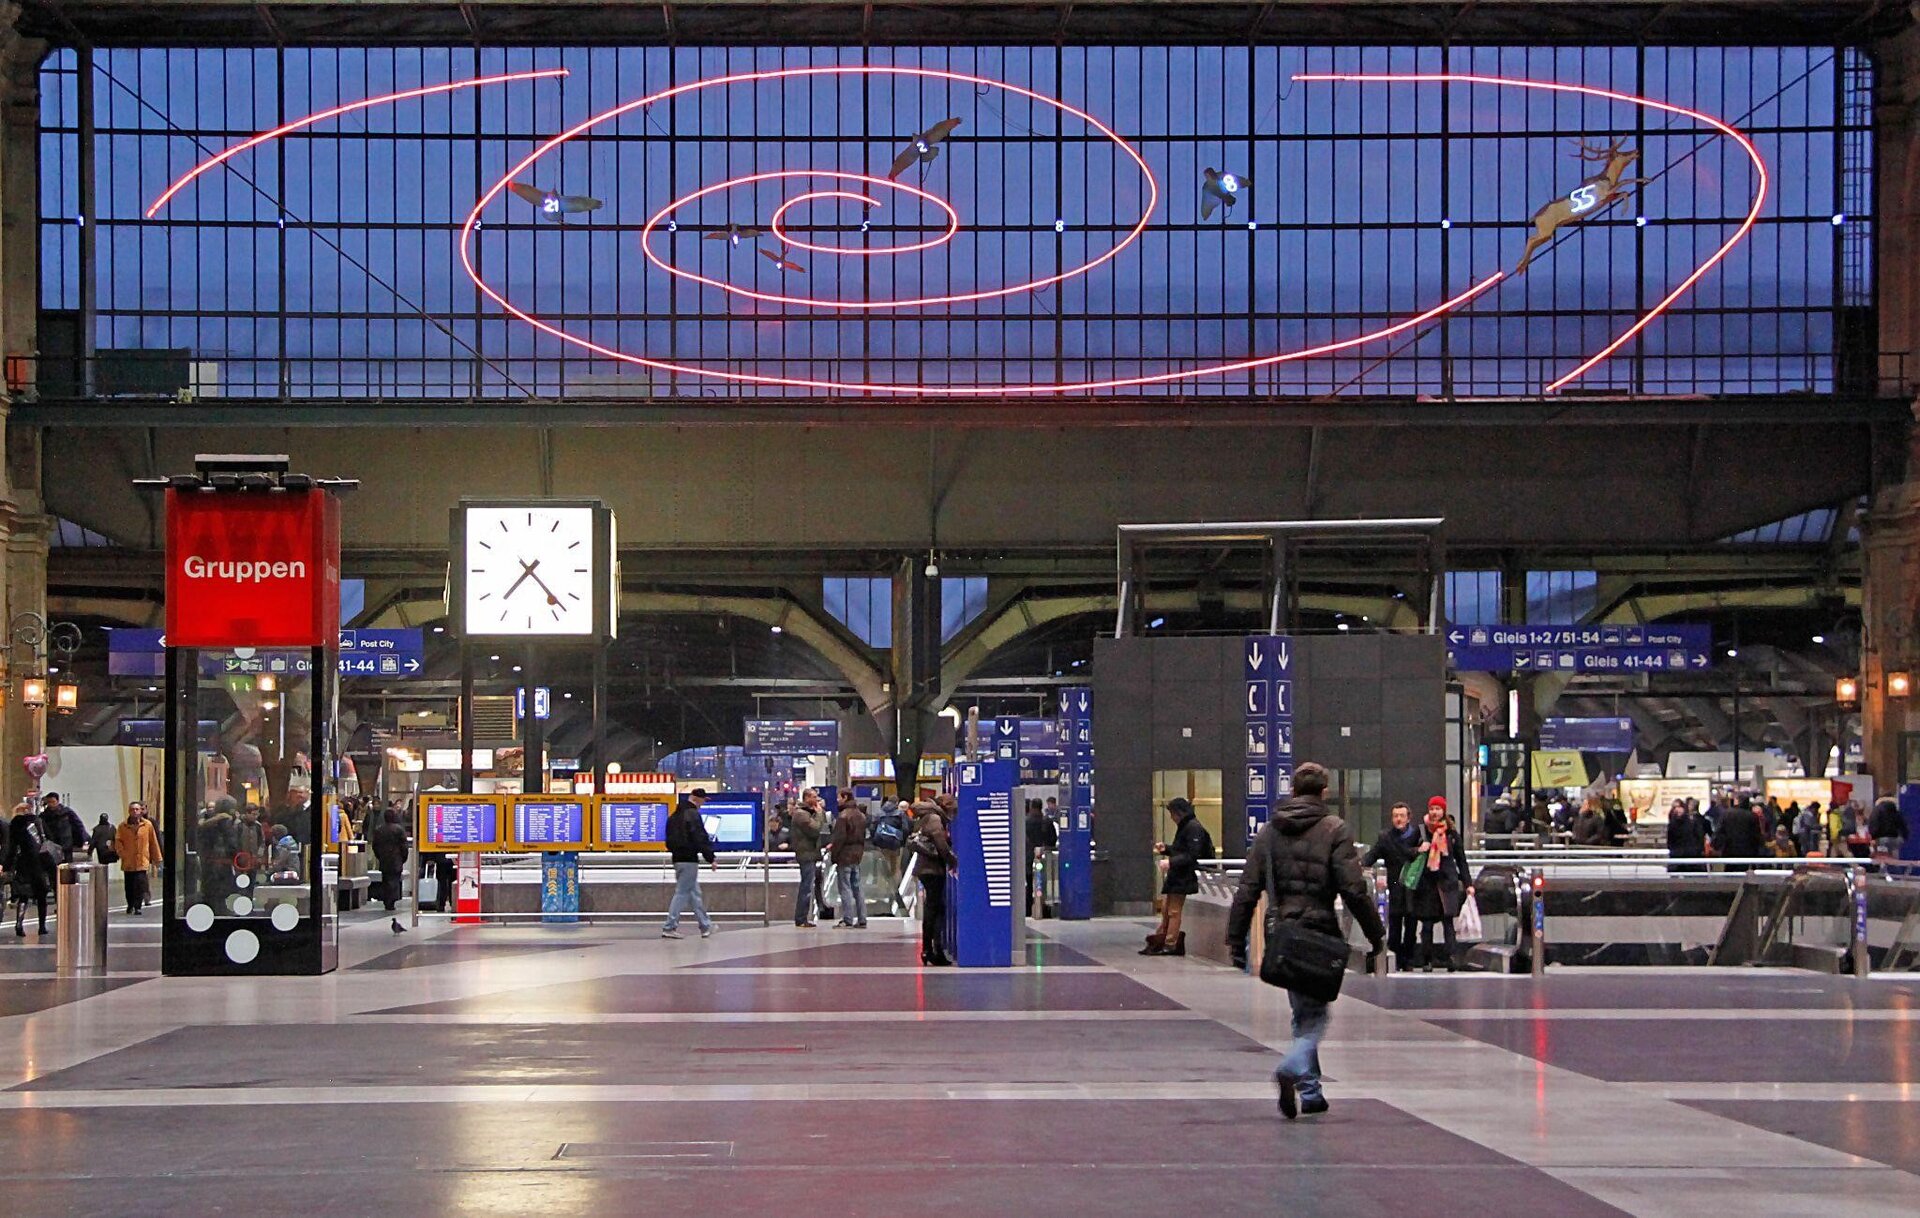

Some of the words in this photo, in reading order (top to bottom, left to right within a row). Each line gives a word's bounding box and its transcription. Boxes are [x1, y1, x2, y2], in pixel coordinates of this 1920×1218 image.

[1223, 174, 1238, 193] 8
[543, 198, 559, 213] 21
[474, 221, 482, 230] 2
[668, 221, 677, 231] 3
[861, 221, 870, 231] 5
[1055, 220, 1065, 232] 8
[184, 556, 305, 583] Gruppen
[1493, 631, 1527, 643] Gleis
[1563, 631, 1600, 643] 51-54
[1648, 635, 1665, 644] Post
[1667, 635, 1682, 645] City
[361, 640, 377, 649] Post
[380, 640, 395, 650] City
[338, 660, 375, 671] 41-44
[1584, 655, 1618, 668] Gleis
[1623, 655, 1663, 667] 41-44
[1060, 728, 1070, 741] 41
[1079, 728, 1089, 741] 41
[1059, 772, 1070, 785] 44
[1078, 772, 1089, 785] 44
